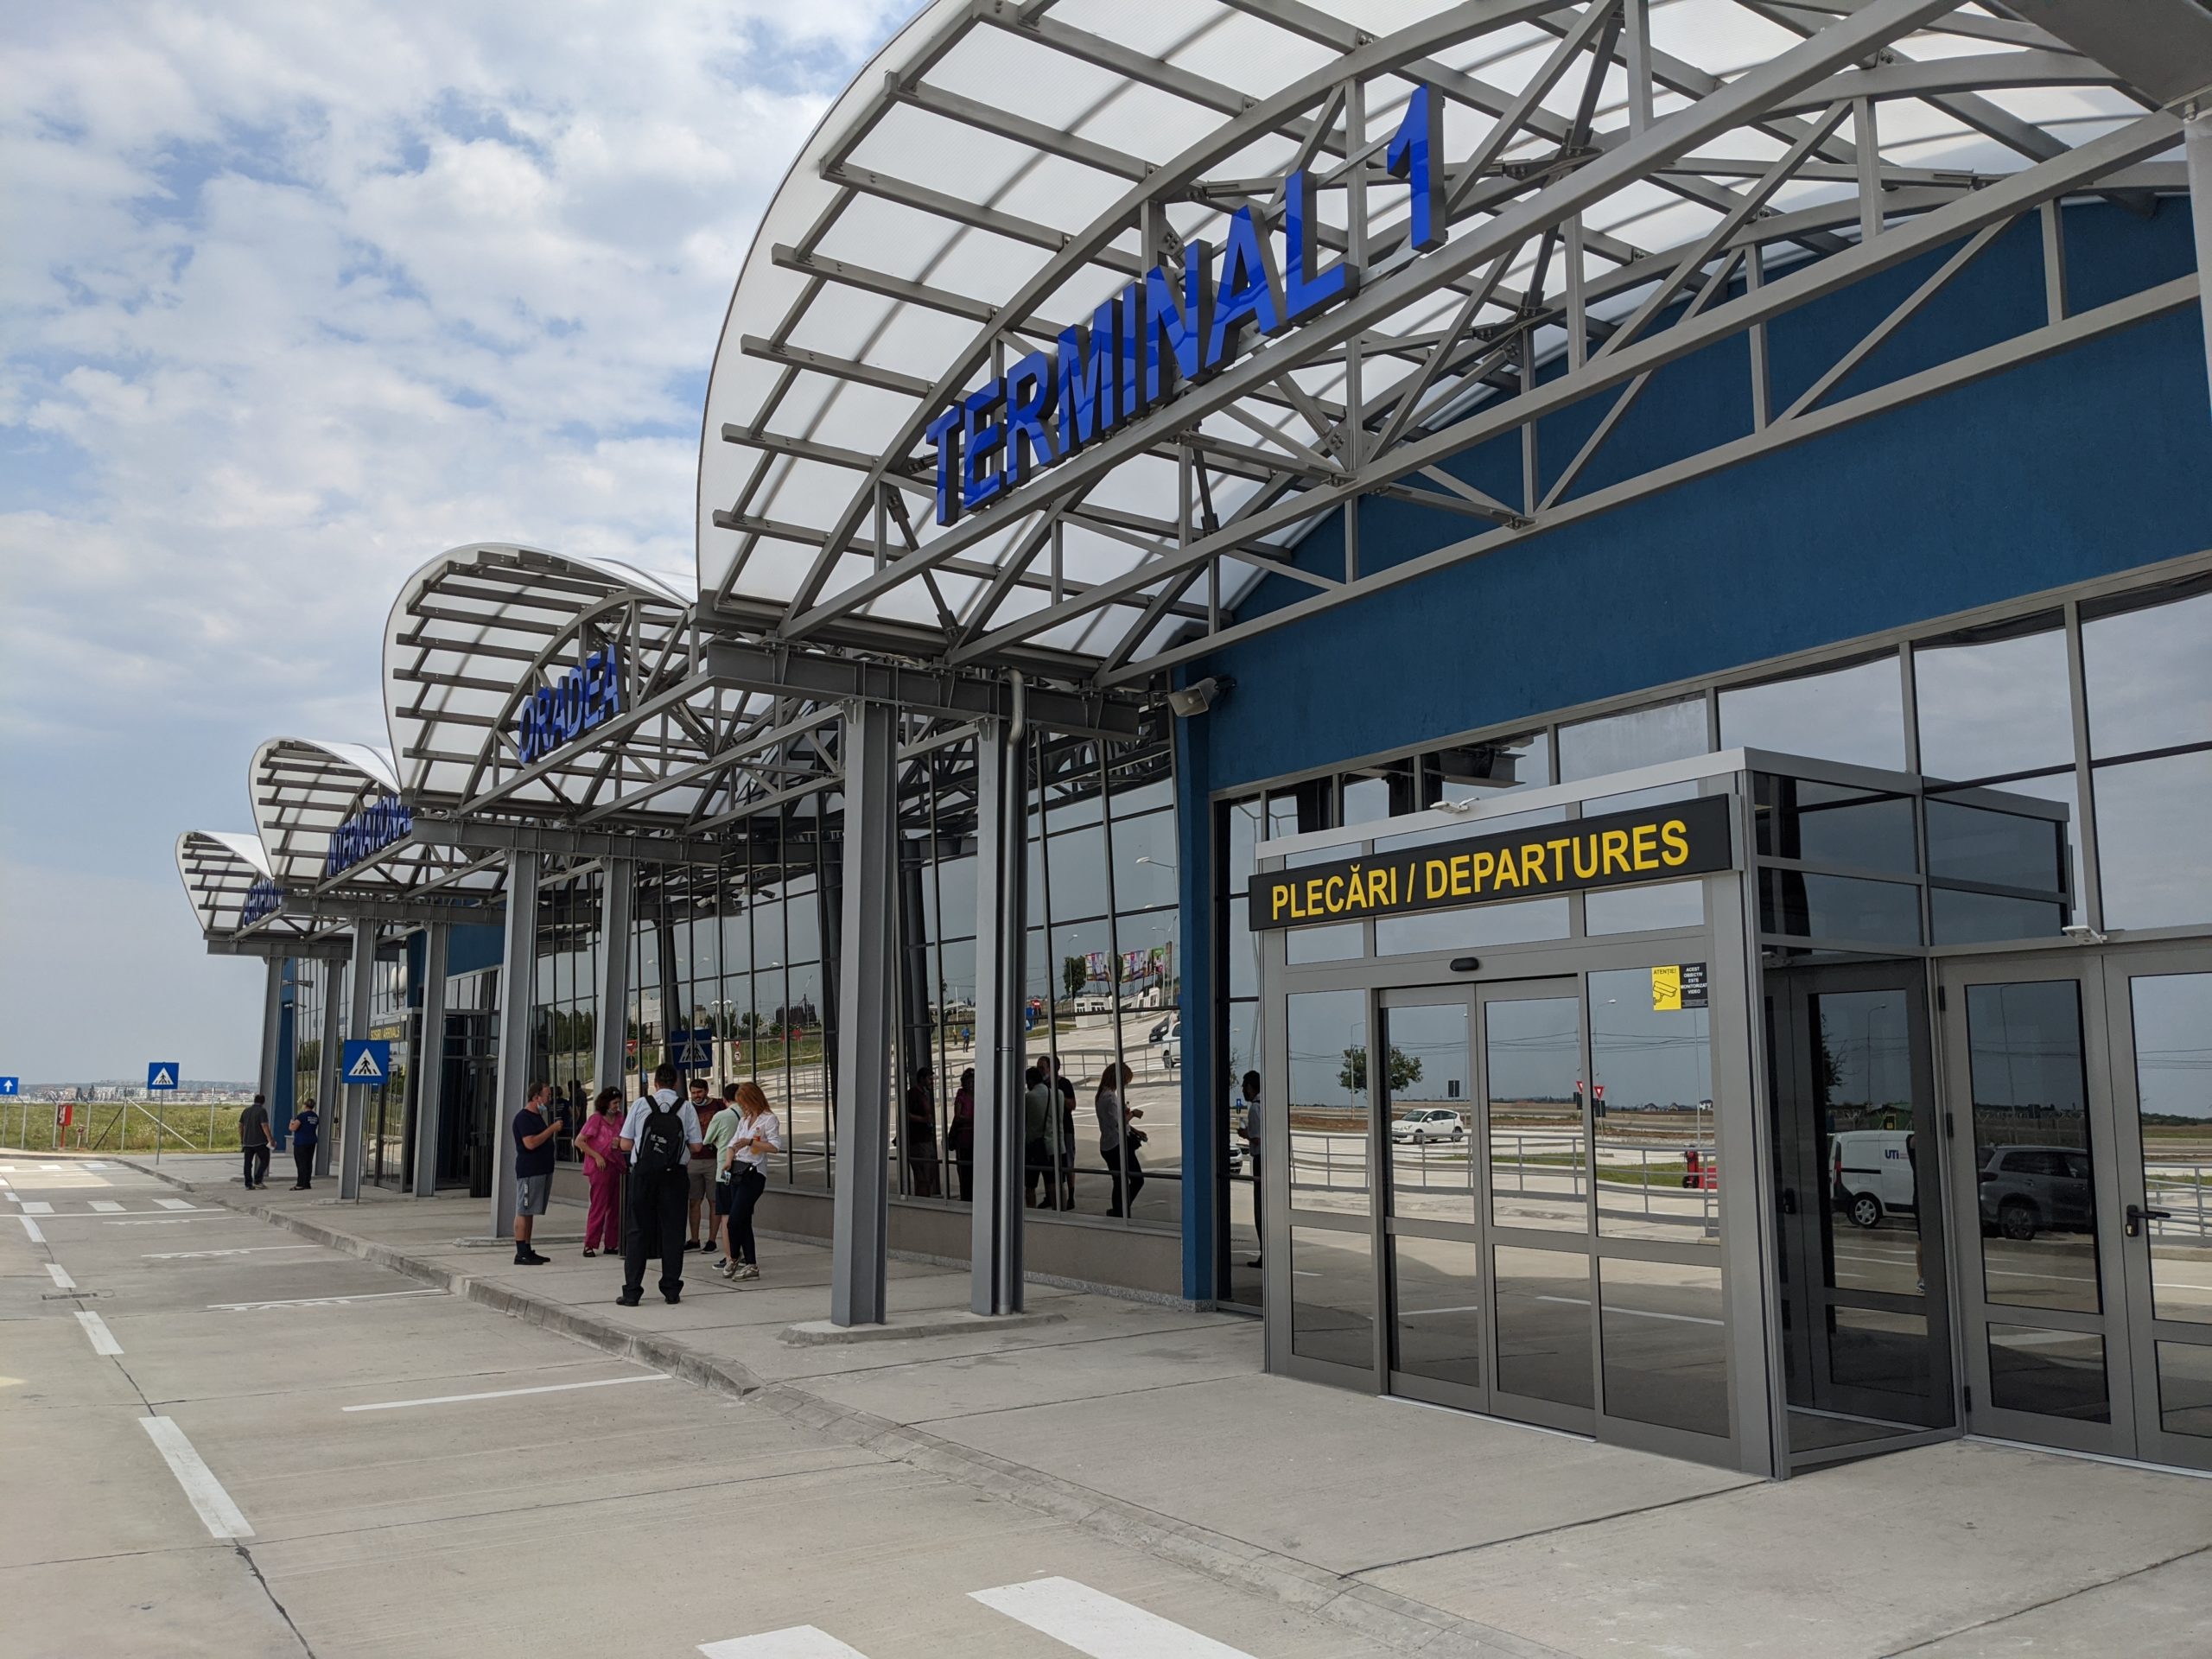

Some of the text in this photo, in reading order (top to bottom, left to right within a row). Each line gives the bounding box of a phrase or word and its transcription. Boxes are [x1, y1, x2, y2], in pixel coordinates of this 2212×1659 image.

[926, 82, 1446, 526] TERMINAL 1
[519, 643, 627, 764] ORADEA
[1272, 819, 1689, 920] PLECĂRI / DEPARTURES
